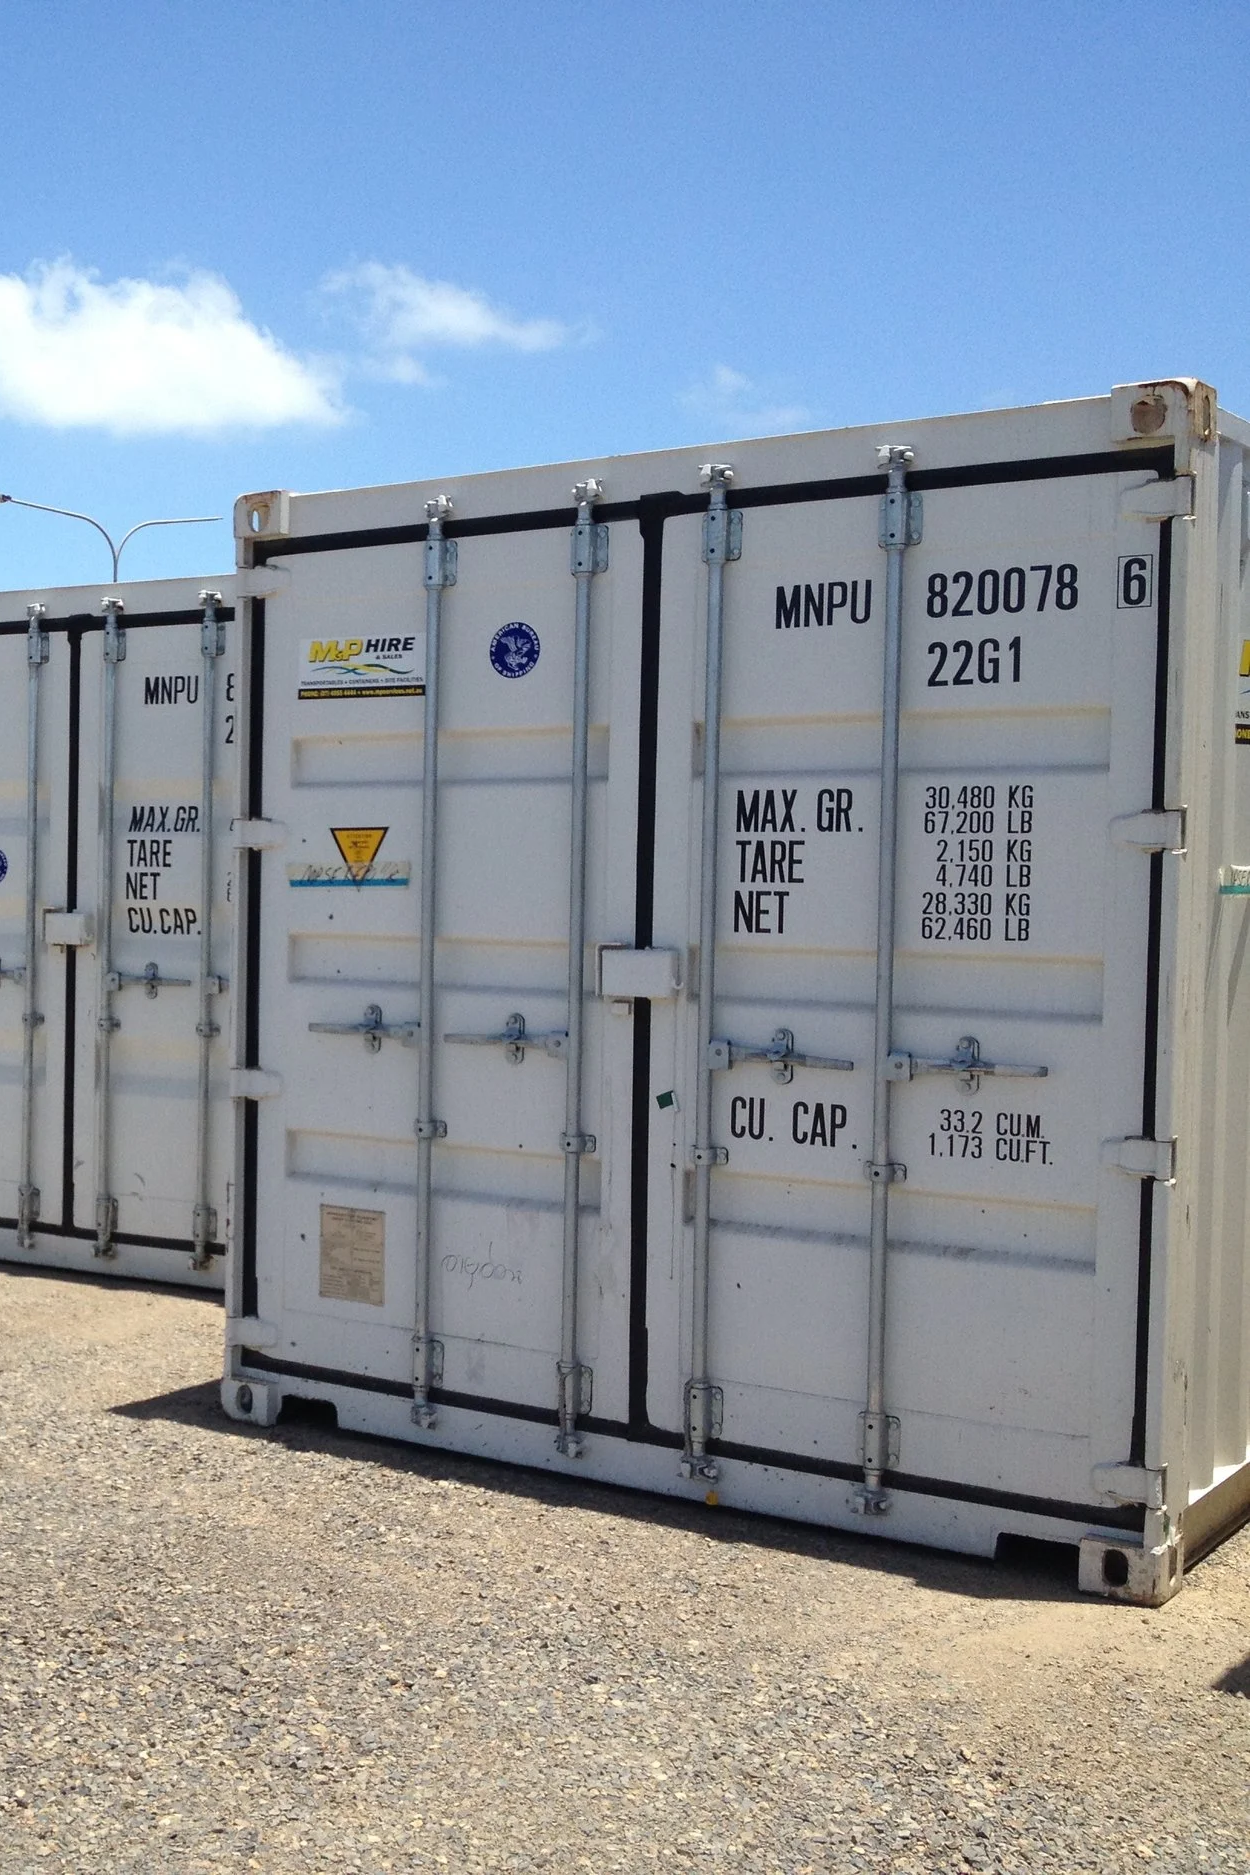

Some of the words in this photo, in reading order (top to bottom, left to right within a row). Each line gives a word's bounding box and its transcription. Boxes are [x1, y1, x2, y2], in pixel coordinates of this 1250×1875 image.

[775, 579, 872, 630] MNPU
[926, 563, 1079, 619] 820078
[1123, 557, 1147, 606] 6
[364, 636, 416, 653] HIRE
[927, 635, 1021, 688] 22G1
[144, 675, 199, 705] MNPU
[735, 789, 806, 833] MAX.
[816, 788, 863, 833] GR.
[925, 785, 995, 810] 30,480
[1008, 784, 1034, 809] KG
[924, 810, 994, 835] 67,200
[1007, 810, 1033, 834] LB
[126, 839, 173, 868] TARE
[735, 839, 806, 884] TARE
[936, 839, 993, 863] 2,150
[1006, 839, 1032, 863] KG
[125, 871, 161, 901] NET
[935, 864, 993, 888] 4,740
[1006, 864, 1031, 888] LB
[733, 890, 790, 934] NET
[922, 891, 992, 916] 28,330
[1005, 892, 1031, 917] KG
[921, 916, 992, 941] 62,460
[1004, 917, 1030, 942] LB
[730, 1095, 774, 1142] CU.
[792, 1101, 857, 1150] CAP.
[939, 1108, 983, 1135] 33.2
